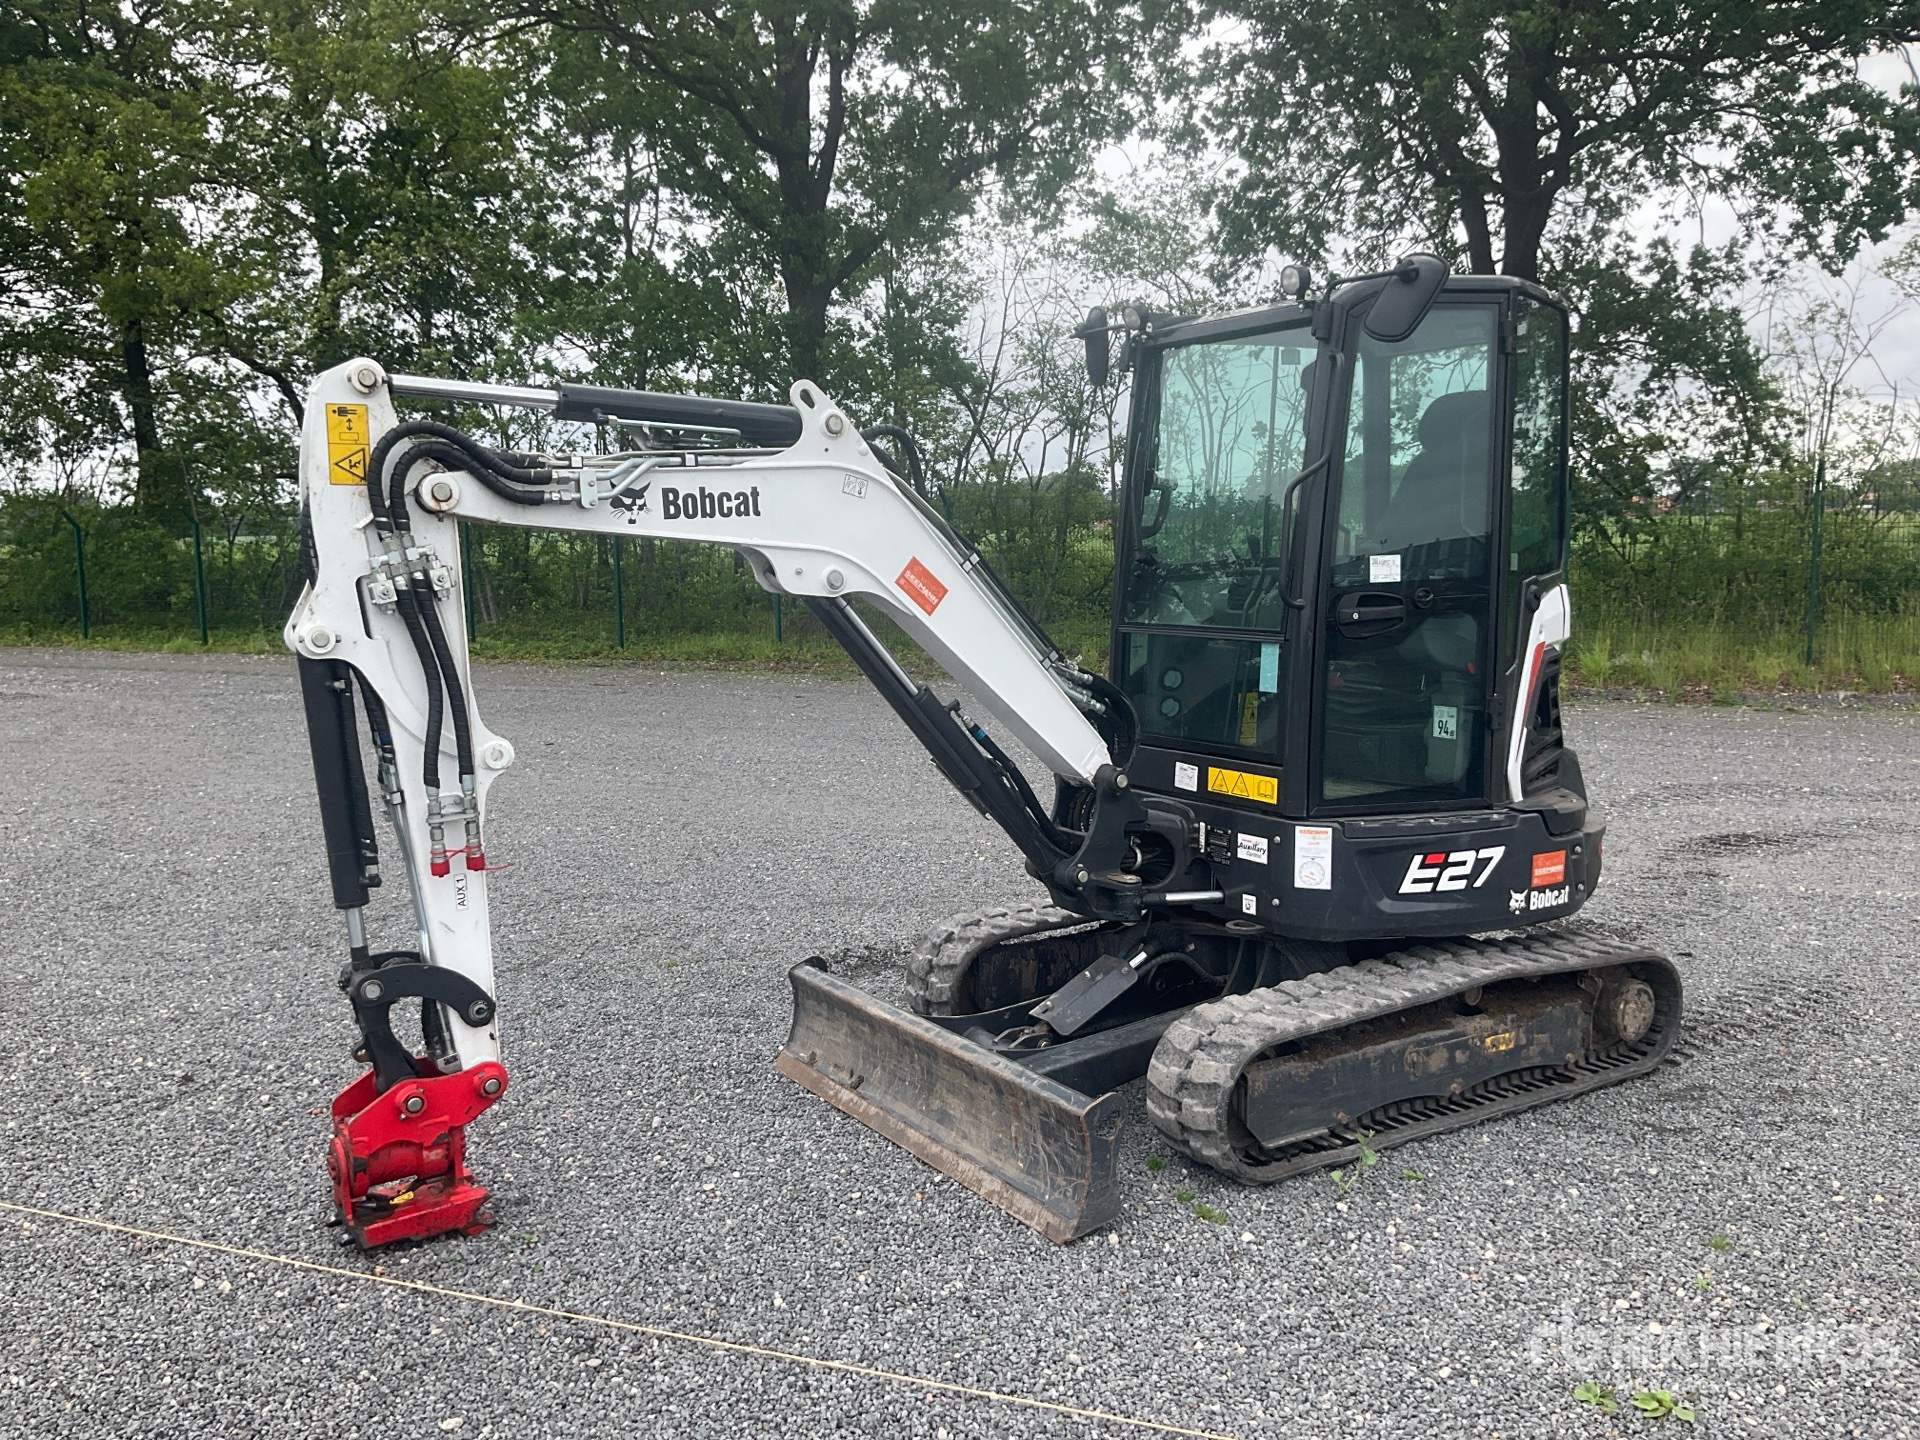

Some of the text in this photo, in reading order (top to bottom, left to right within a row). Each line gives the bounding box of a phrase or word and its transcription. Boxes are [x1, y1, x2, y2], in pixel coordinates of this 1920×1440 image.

[661, 487, 761, 519] Bobcat
[1437, 719, 1449, 736] 94
[1398, 845, 1506, 895] E27
[456, 885, 466, 907] AUX
[1529, 885, 1570, 911] Bobcat
